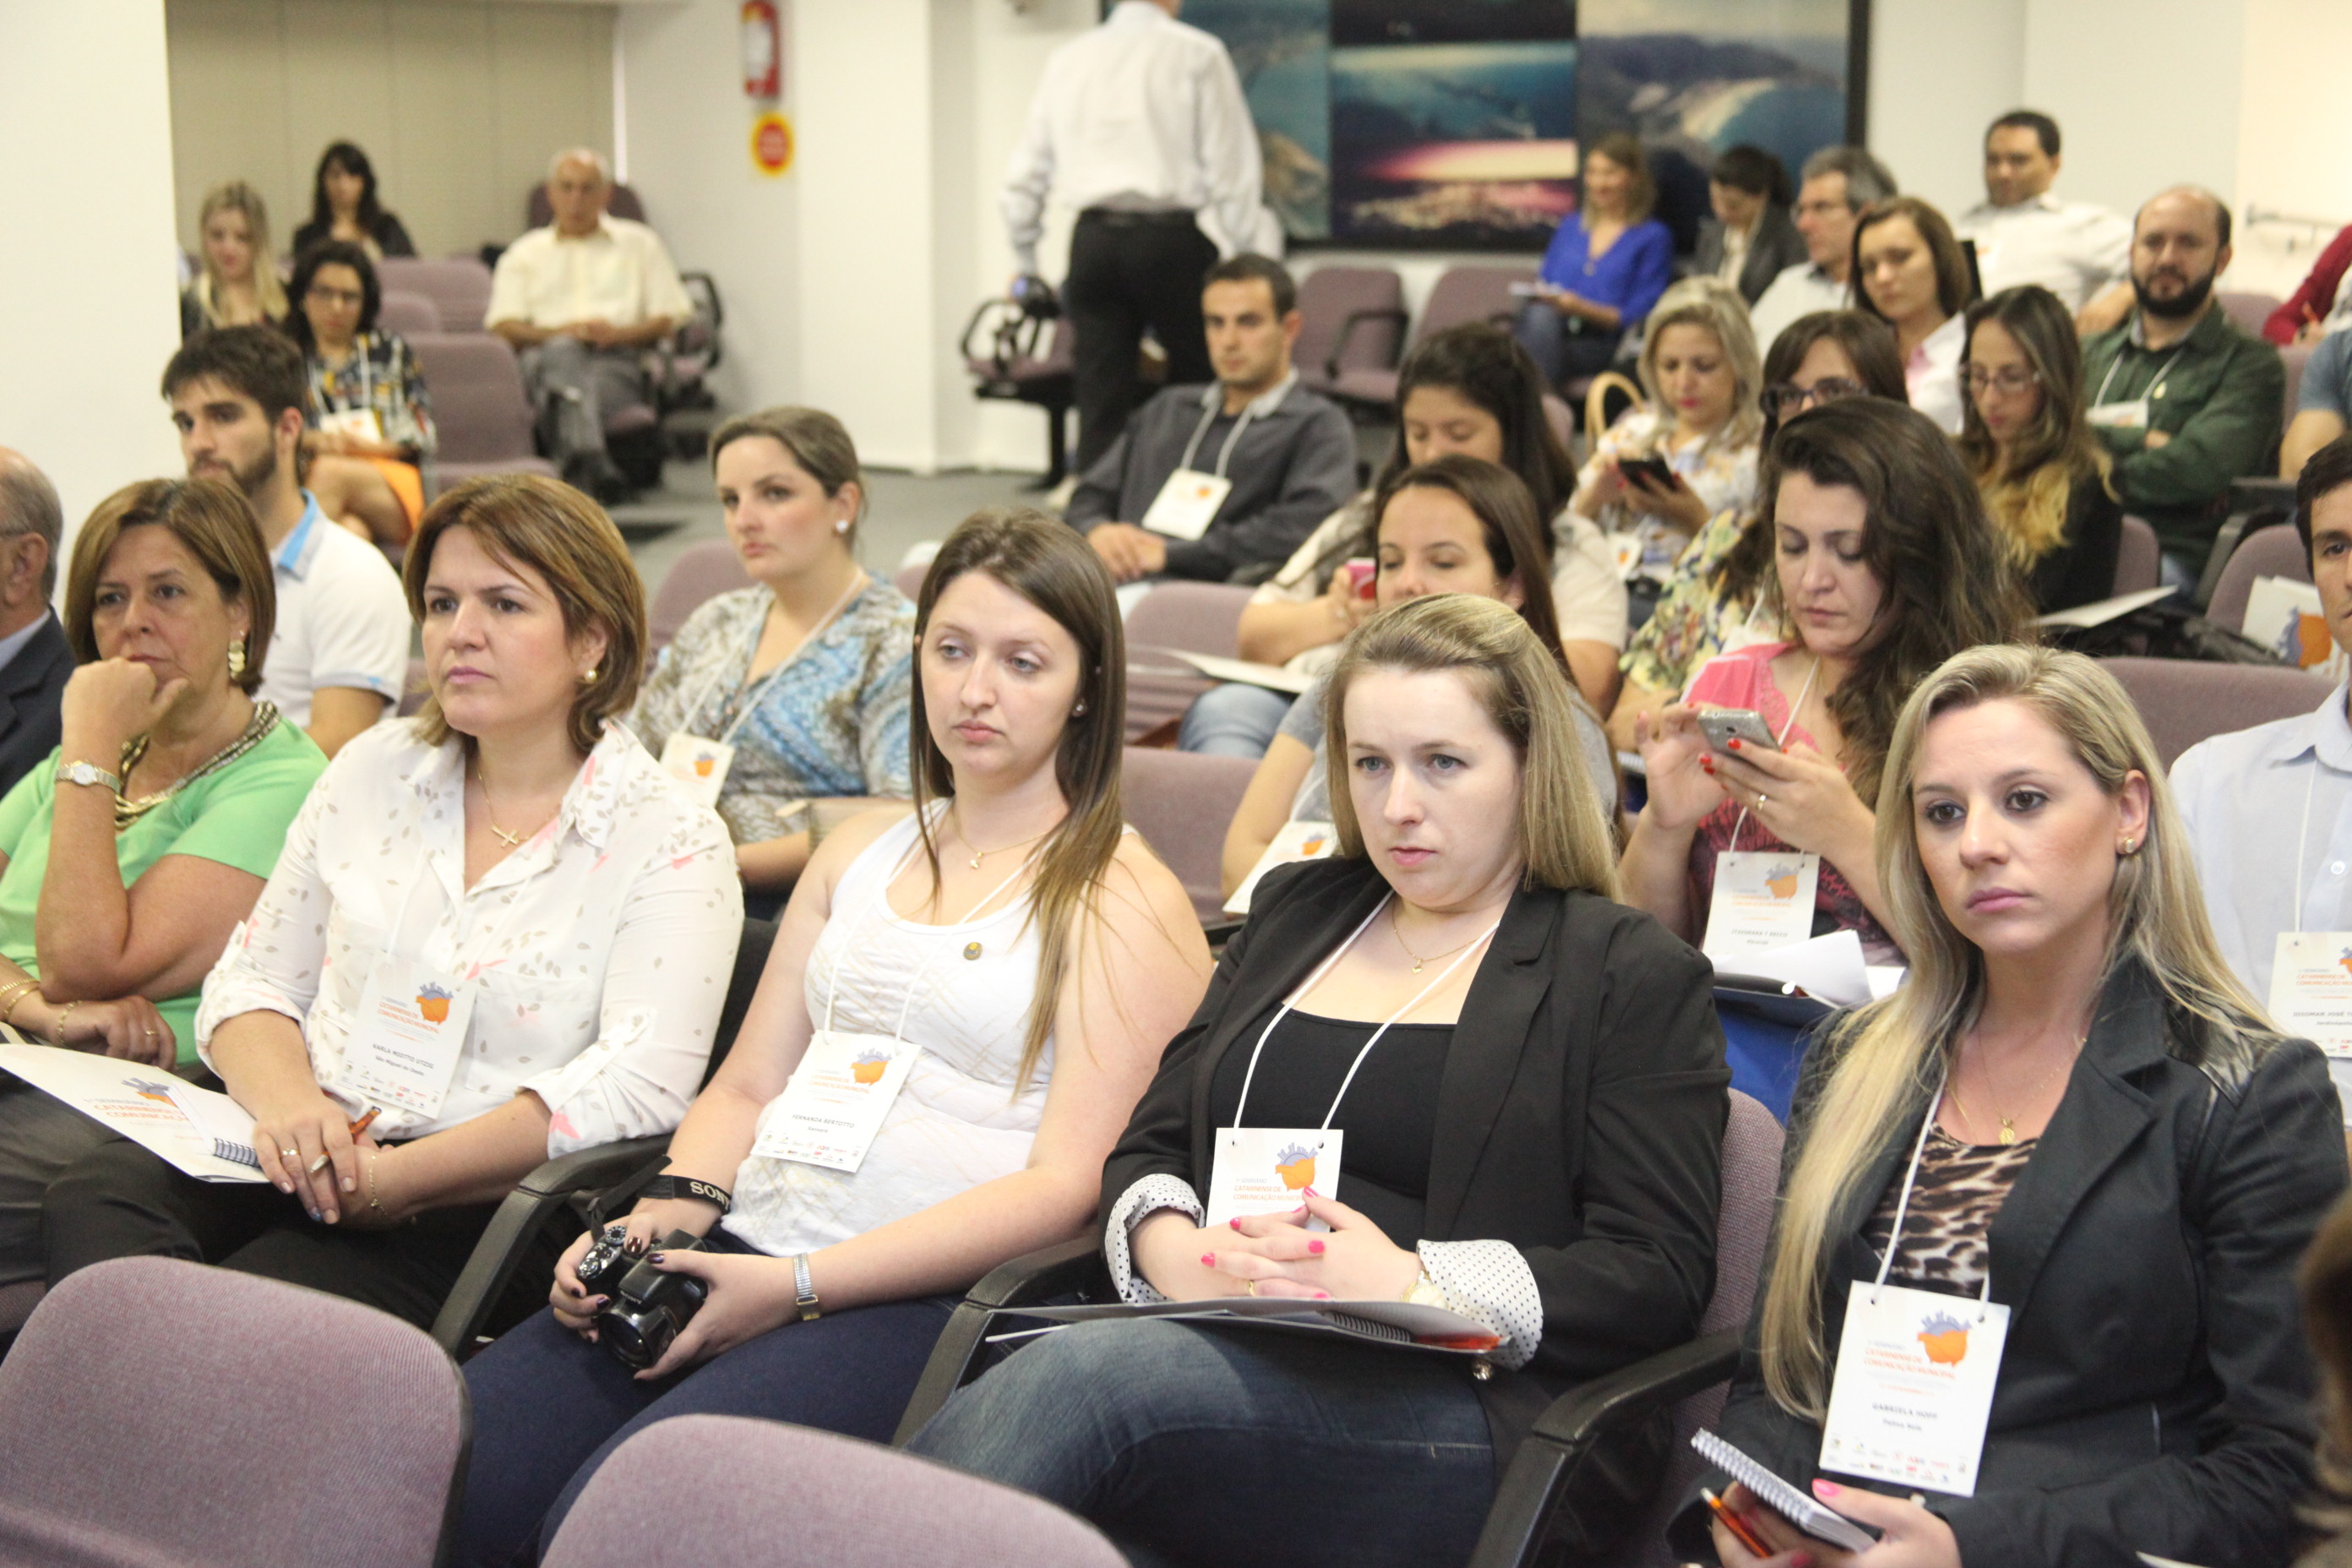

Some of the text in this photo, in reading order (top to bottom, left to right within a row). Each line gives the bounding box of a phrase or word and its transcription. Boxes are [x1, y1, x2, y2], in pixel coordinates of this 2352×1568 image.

[792, 1113, 855, 1129] FERNANDA BERTOTTO
[1233, 1193, 1276, 1201] COMUNICAÇÃO
